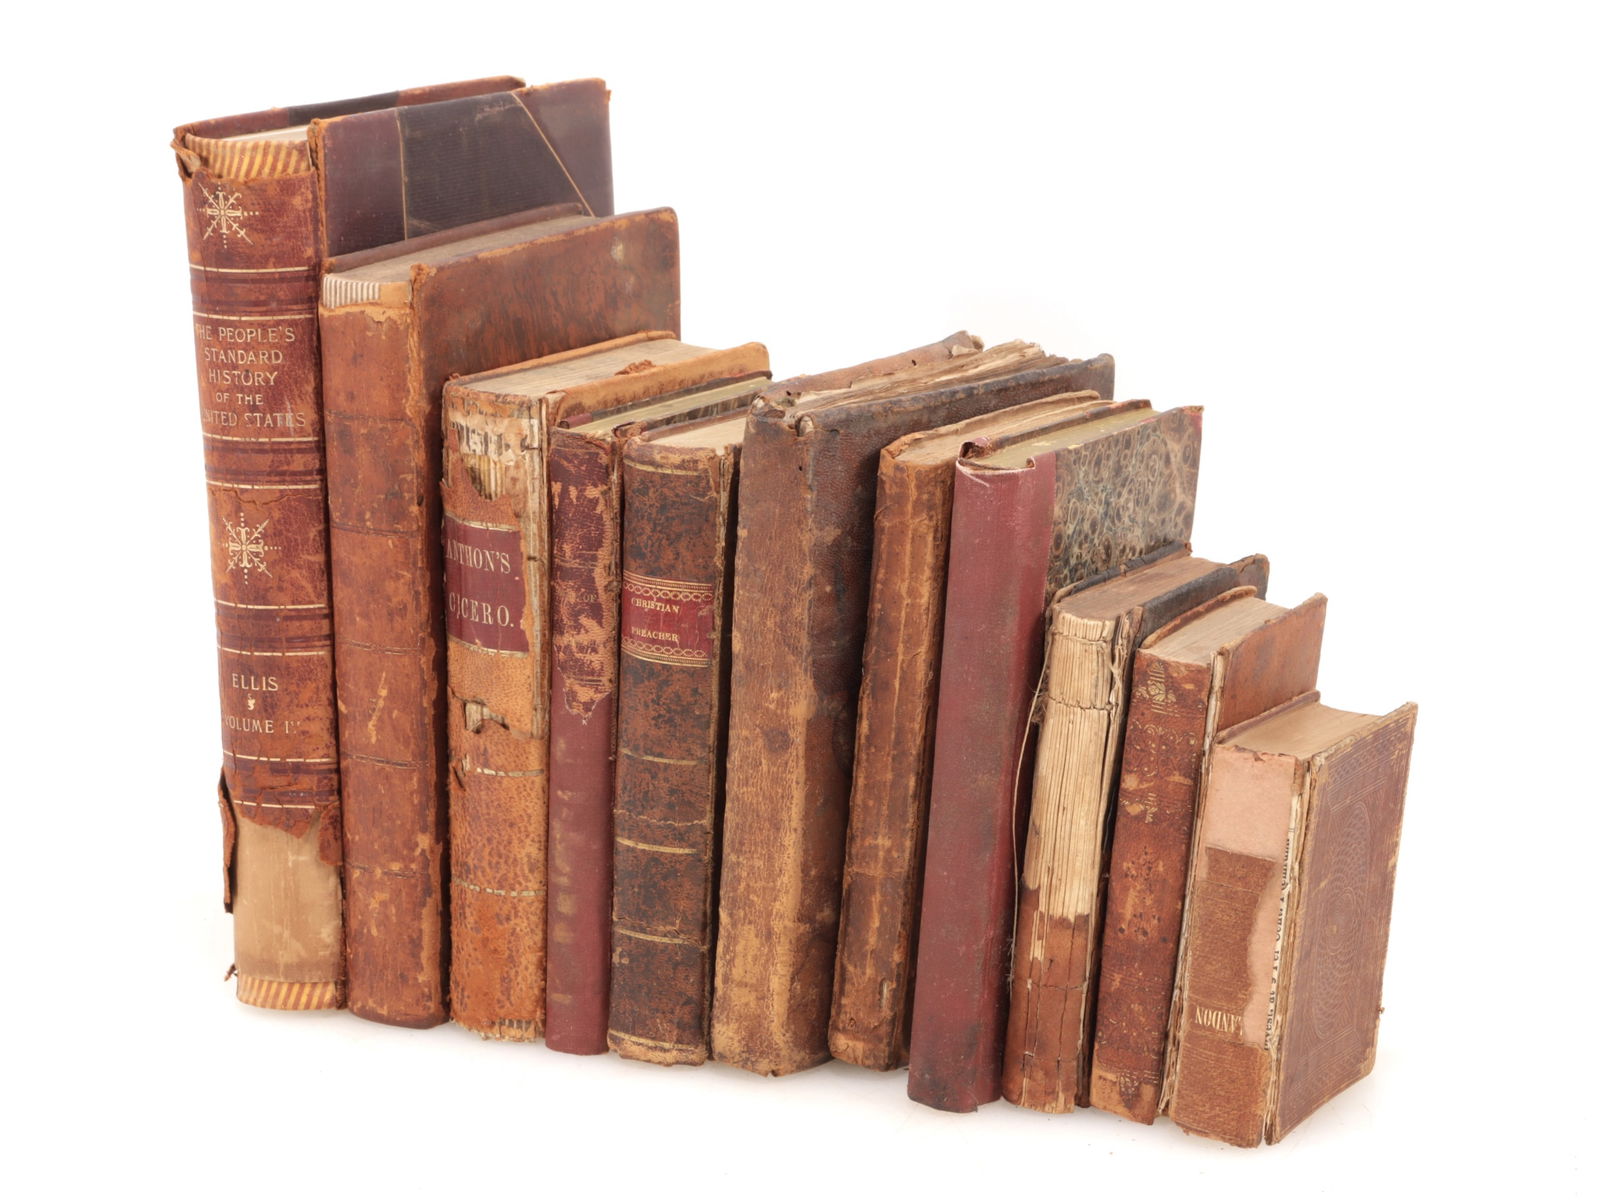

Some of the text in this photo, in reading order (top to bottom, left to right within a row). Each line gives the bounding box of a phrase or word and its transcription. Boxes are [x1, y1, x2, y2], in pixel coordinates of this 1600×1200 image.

[218, 326, 296, 343] PEOPLE'S
[204, 347, 283, 365] STANDARD
[208, 369, 278, 386] HISTORY
[216, 392, 264, 405] OF THE
[244, 412, 305, 428] STATES
[446, 539, 511, 574] ANTHON'S
[448, 592, 515, 628] CICERO.
[631, 597, 680, 614] CHRISTIAN
[631, 626, 678, 641] PREACHER
[232, 673, 279, 691] ELLIS
[224, 714, 275, 734] VOLUME
